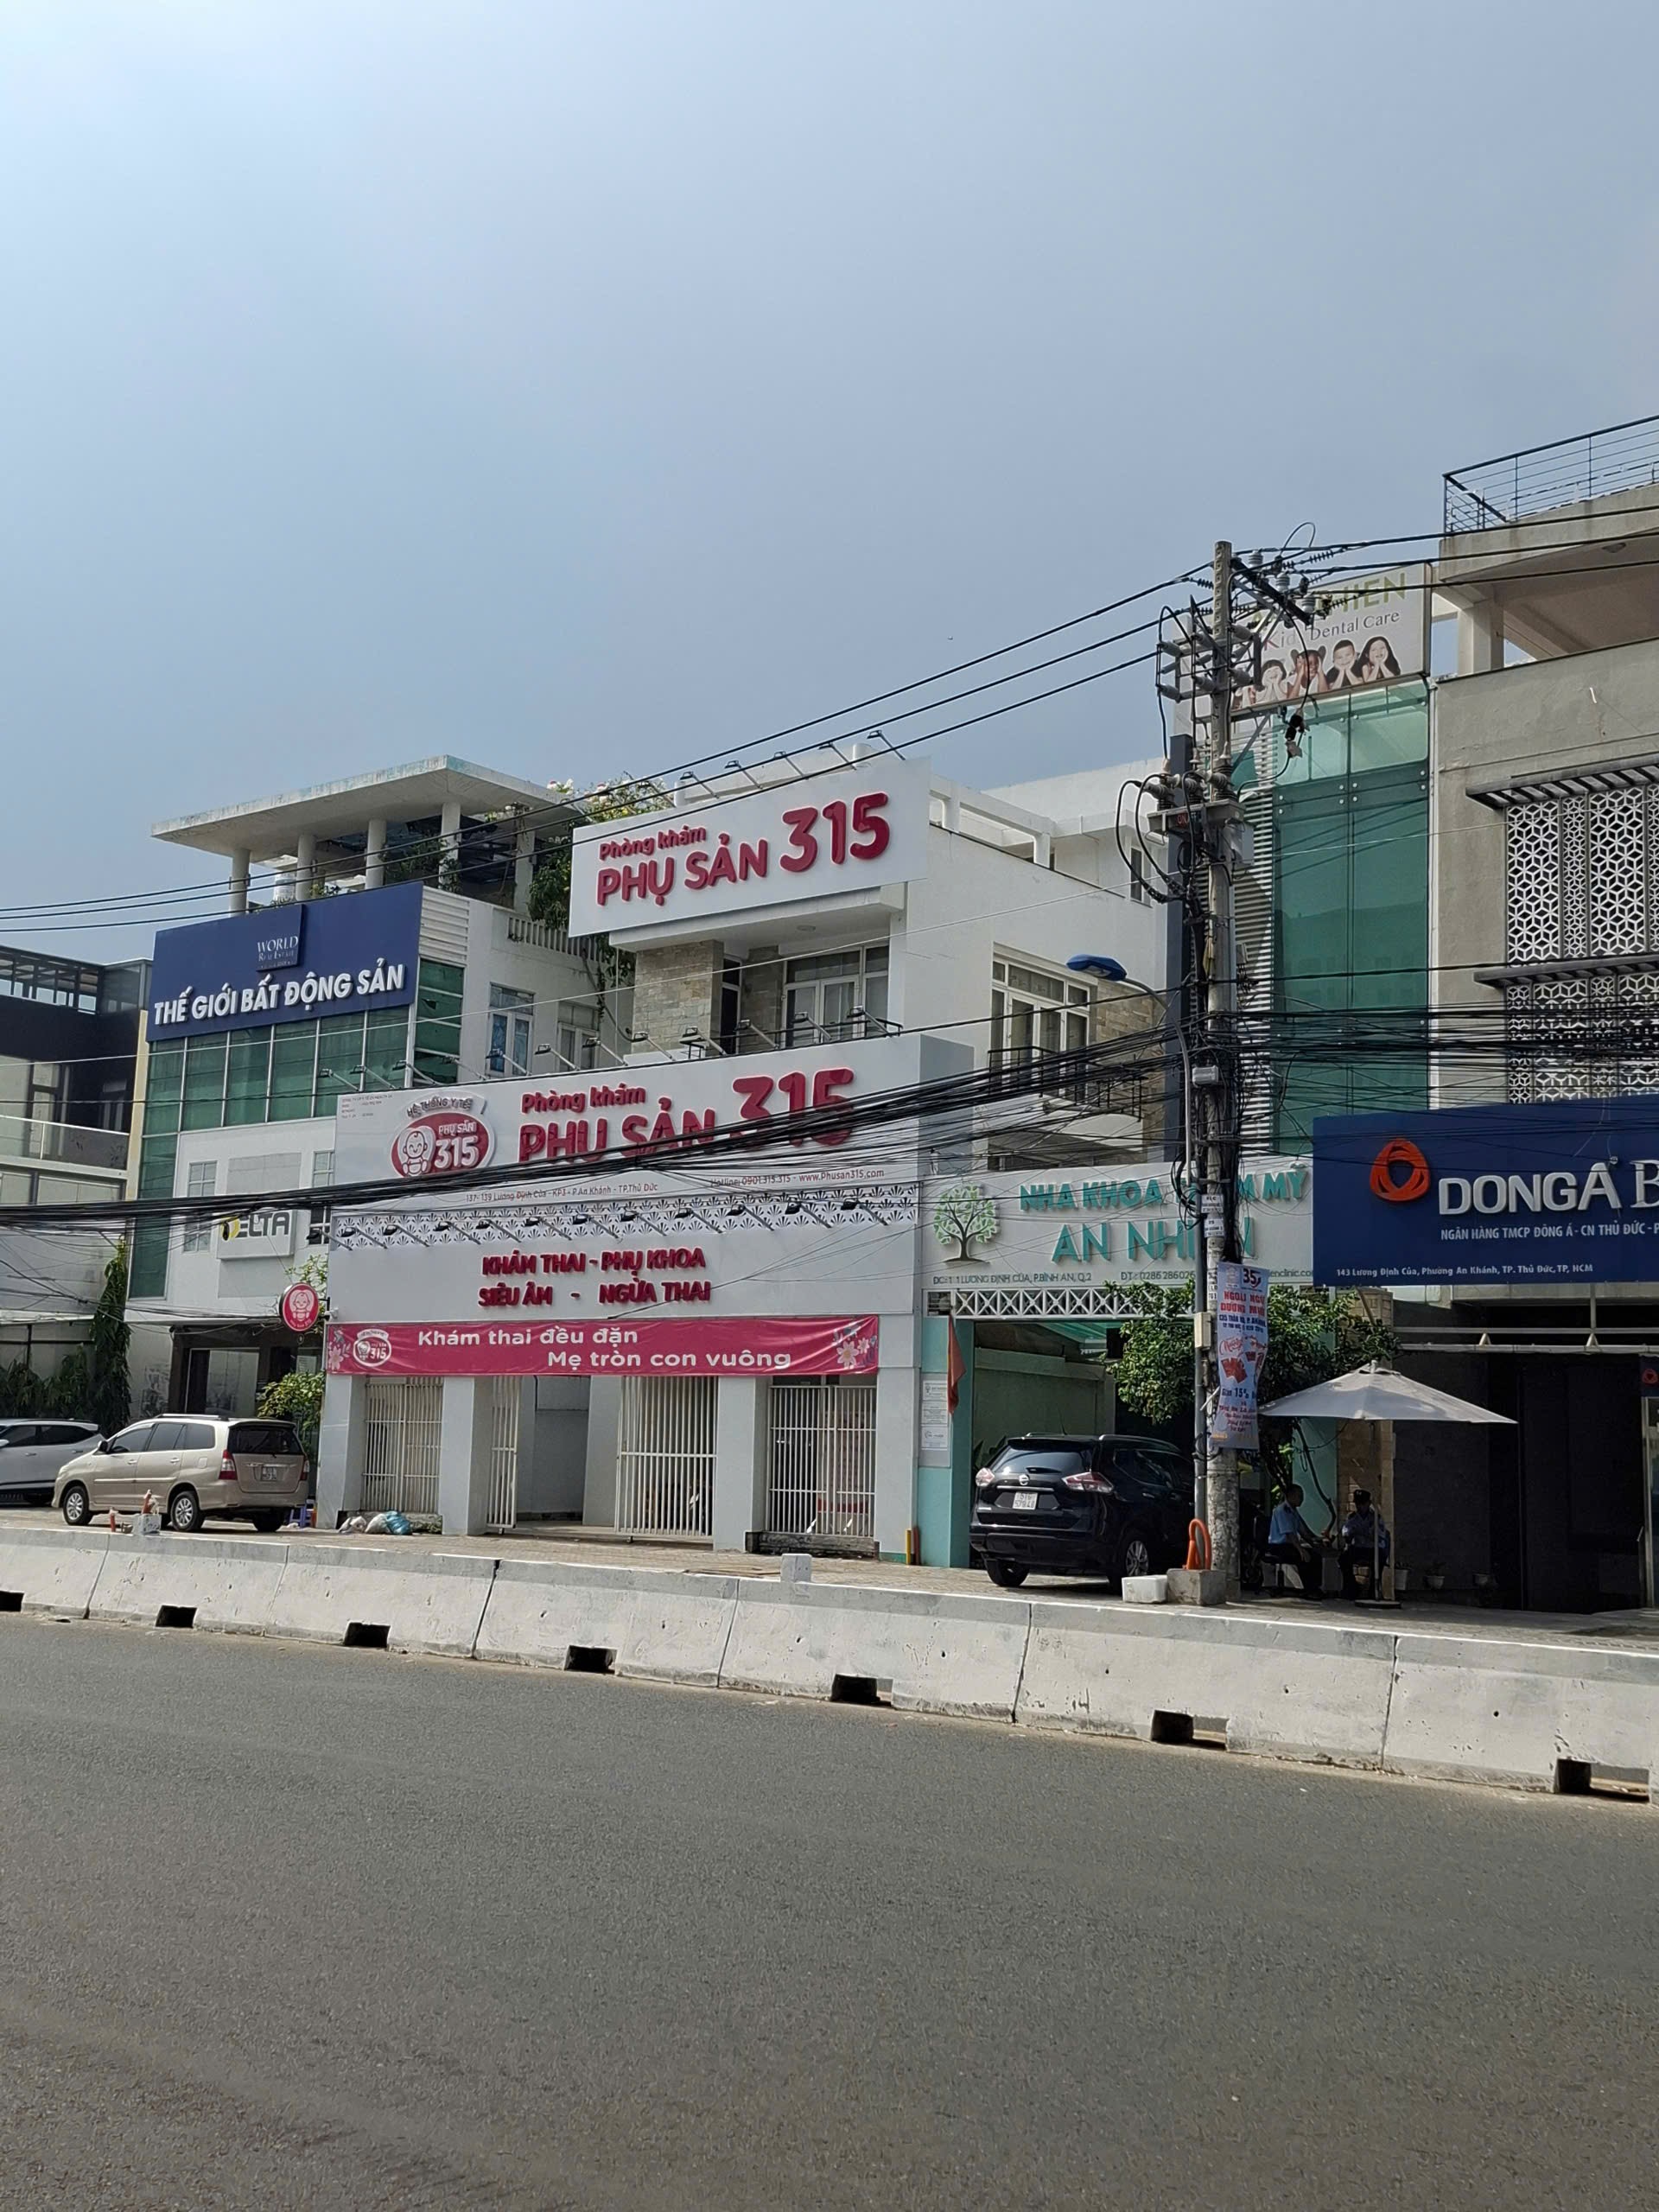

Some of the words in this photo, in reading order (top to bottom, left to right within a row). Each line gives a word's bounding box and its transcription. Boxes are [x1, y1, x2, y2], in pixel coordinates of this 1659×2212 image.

[1310, 615, 1358, 640] Dental
[1363, 611, 1400, 628] Care
[596, 856, 676, 906] PHỤ
[683, 832, 769, 891] SẢN
[779, 791, 891, 874] 315
[599, 836, 656, 861] Phòng
[657, 824, 707, 849] khám
[257, 935, 299, 953] WORLD
[154, 985, 193, 1025] THẾ
[192, 982, 238, 1020] GIỚI
[240, 972, 281, 1013] BẤT
[283, 970, 353, 1012] ĐỘNG
[356, 957, 406, 995] SẢN
[520, 1090, 586, 1114] Phòng
[589, 1082, 647, 1109] khám
[438, 1125, 456, 1136] PHỤ
[620, 1096, 716, 1159] SẢN
[434, 1135, 480, 1169] 315
[1020, 1182, 1077, 1211] NHA
[1082, 1179, 1163, 1209] KHOA
[1262, 1163, 1307, 1200] MỸ
[1051, 1222, 1112, 1263] AN
[1440, 1226, 1469, 1241] NGÂN
[1471, 1224, 1499, 1240] HÀNG
[1502, 1226, 1531, 1239] TMCP
[1533, 1224, 1563, 1238] ĐÔNG
[1580, 1224, 1595, 1236] CN
[1598, 1219, 1621, 1236] THỦ
[1622, 1220, 1646, 1235] ĐỨC
[481, 1249, 537, 1275] KHÁM
[540, 1252, 587, 1274] THAI
[601, 1250, 643, 1276] PHỤ
[646, 1247, 706, 1269] KHOA
[1337, 1268, 1351, 1277] 143
[1352, 1267, 1377, 1278] Lương
[1380, 1267, 1400, 1278] Định
[1421, 1265, 1453, 1277] Phường
[1456, 1266, 1468, 1275] An
[1470, 1265, 1501, 1275] Khánh,
[1502, 1265, 1516, 1274] TP.
[1517, 1263, 1535, 1274] Thủ
[1573, 1264, 1593, 1274] HCM
[479, 1281, 520, 1307] SIÊU
[522, 1281, 553, 1306] ÂM
[599, 1277, 658, 1304] NGỪA
[661, 1280, 712, 1303] THAI
[418, 1329, 480, 1346] Khám
[488, 1328, 532, 1345] thai
[539, 1326, 584, 1345] đều
[592, 1327, 638, 1348] đặn
[547, 1351, 581, 1370] Mẹ
[589, 1349, 641, 1367] tròn
[650, 1351, 696, 1367] con
[705, 1350, 791, 1370] vuông
